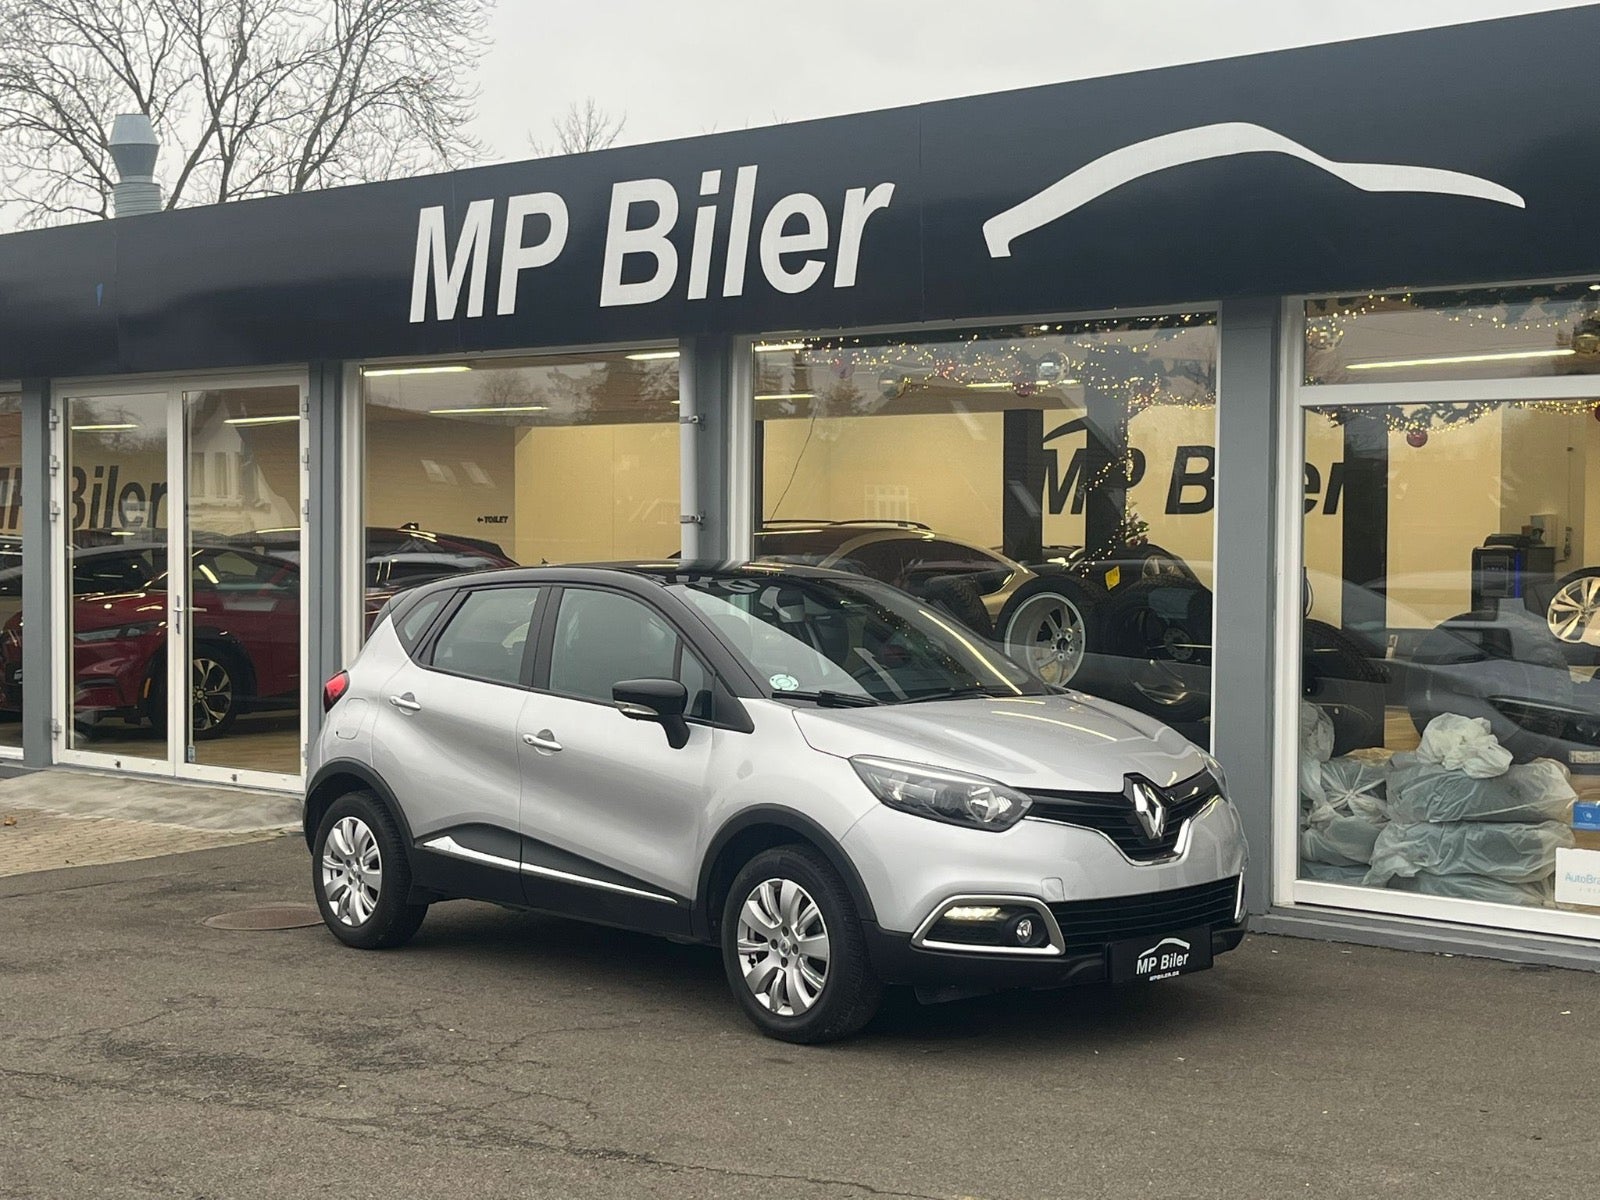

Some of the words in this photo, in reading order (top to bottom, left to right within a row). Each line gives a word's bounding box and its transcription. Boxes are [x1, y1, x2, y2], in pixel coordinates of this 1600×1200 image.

[409, 191, 569, 323] MP
[600, 164, 896, 307] Biler
[484, 515, 509, 524] TOILET
[1136, 957, 1157, 975] MP
[1160, 952, 1189, 970] Biler
